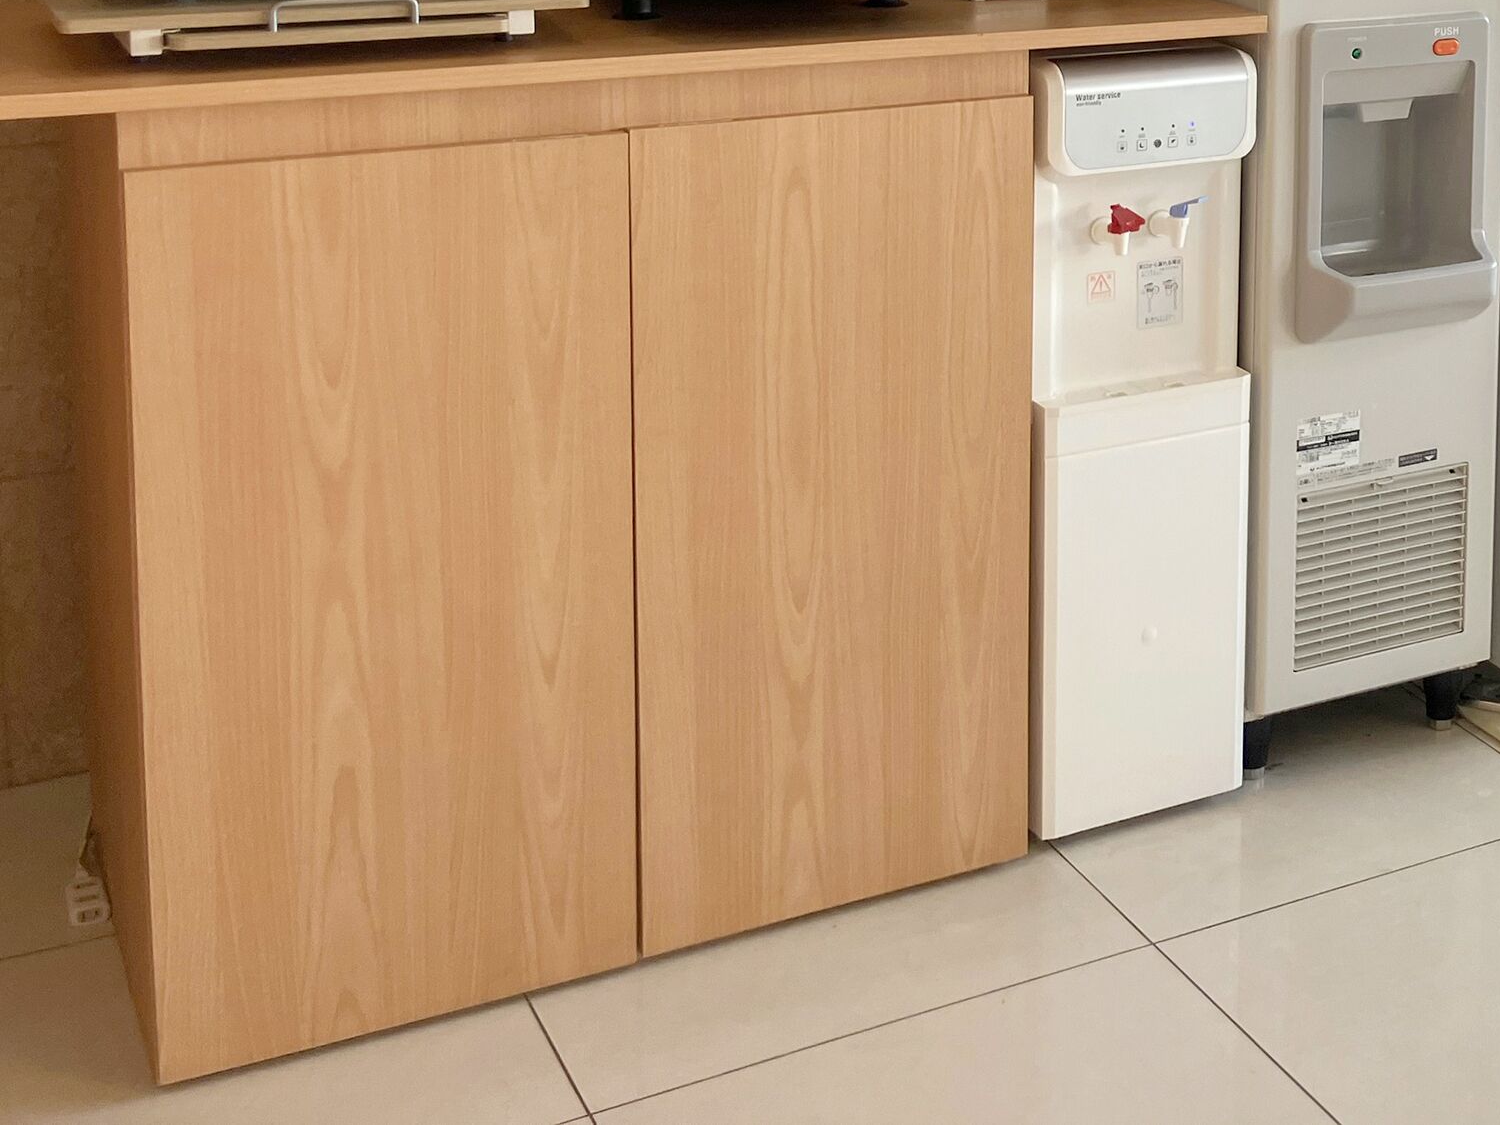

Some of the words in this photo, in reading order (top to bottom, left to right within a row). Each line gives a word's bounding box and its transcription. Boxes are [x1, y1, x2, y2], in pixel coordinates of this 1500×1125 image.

[1434, 26, 1460, 37] PUSH
[1075, 94, 1096, 102] Water
[1097, 91, 1121, 100] service
